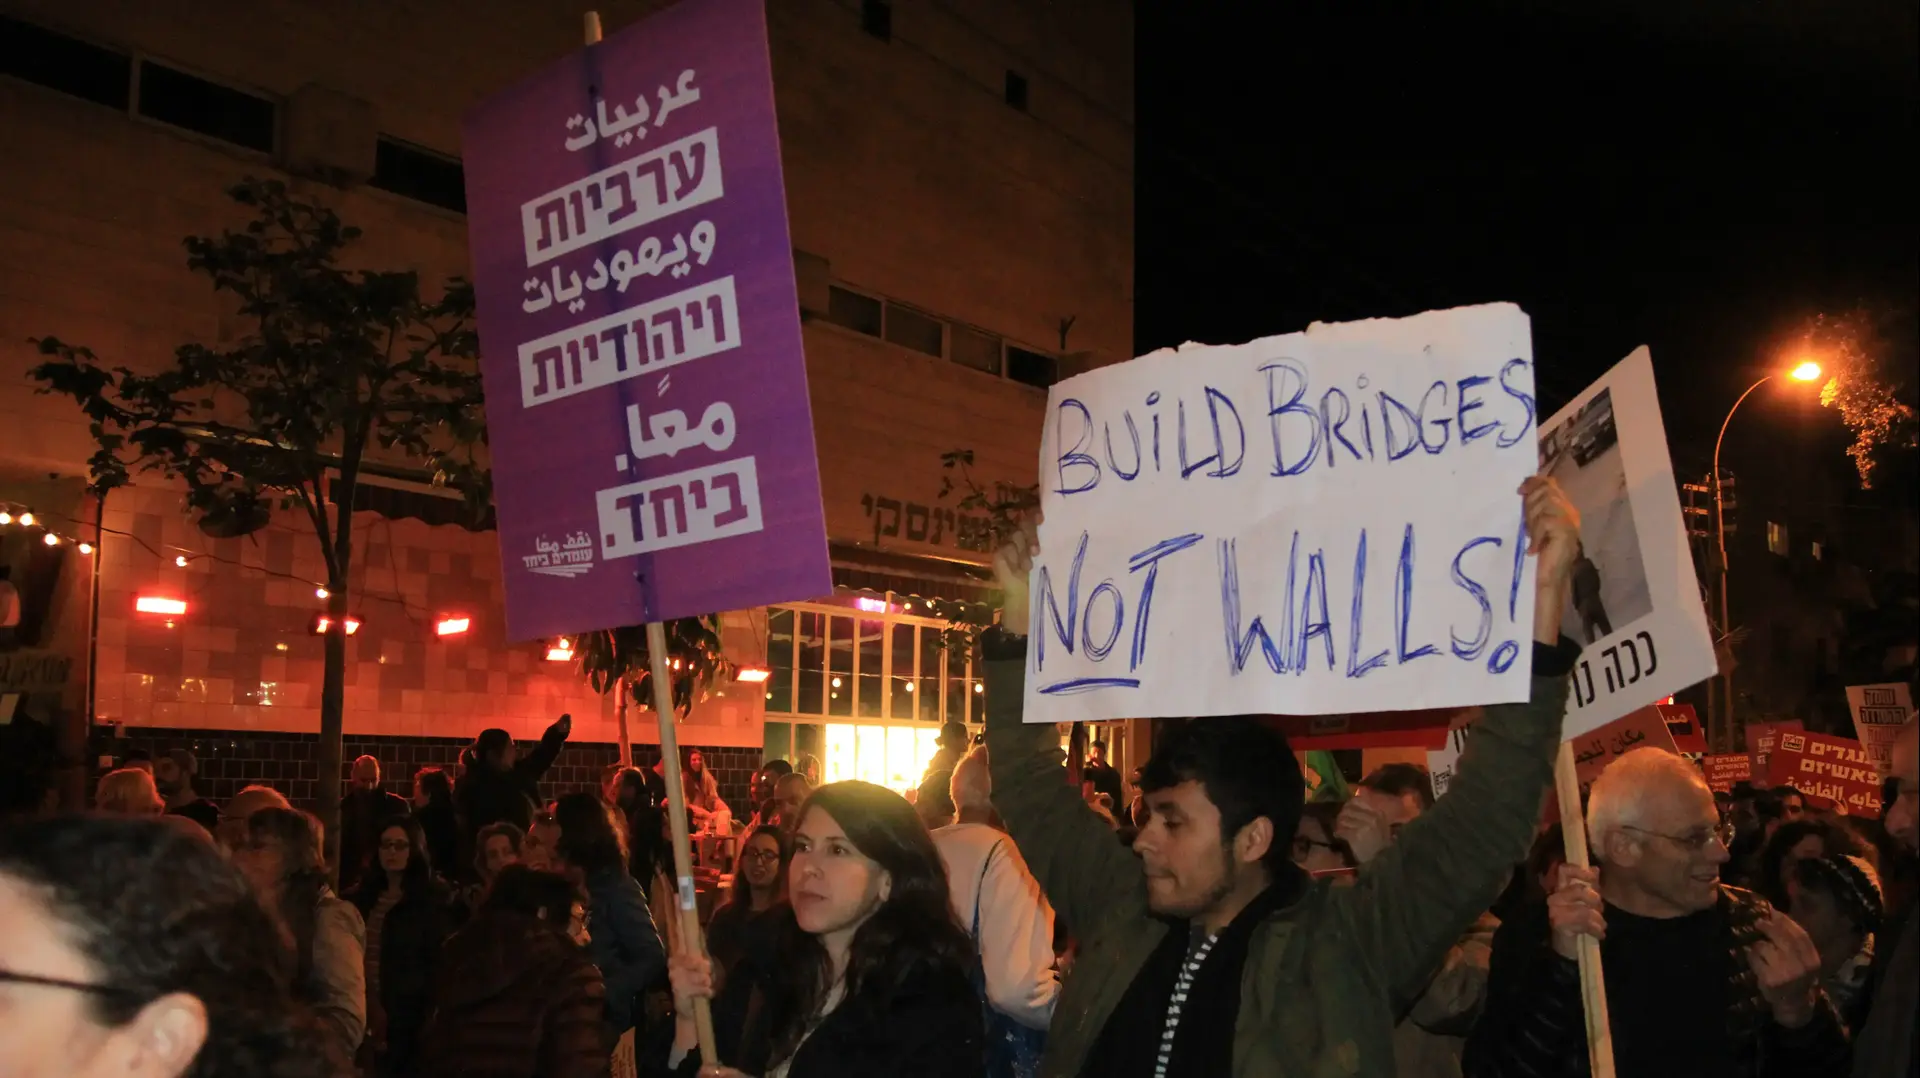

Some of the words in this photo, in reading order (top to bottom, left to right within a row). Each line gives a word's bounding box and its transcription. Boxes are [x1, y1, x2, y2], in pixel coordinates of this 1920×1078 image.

[565, 69, 700, 151] عربيات
[535, 141, 706, 251] ערביות
[522, 220, 716, 314] ويهوديات
[532, 294, 726, 397] ויהודיות
[606, 472, 748, 547] ביחד.
[1033, 529, 1204, 674] NOT
[1217, 506, 1532, 679] WALLS!
[1601, 631, 1657, 694] ככה
[1800, 758, 1880, 786] פאשיזם
[1810, 741, 1870, 764] נגדים
